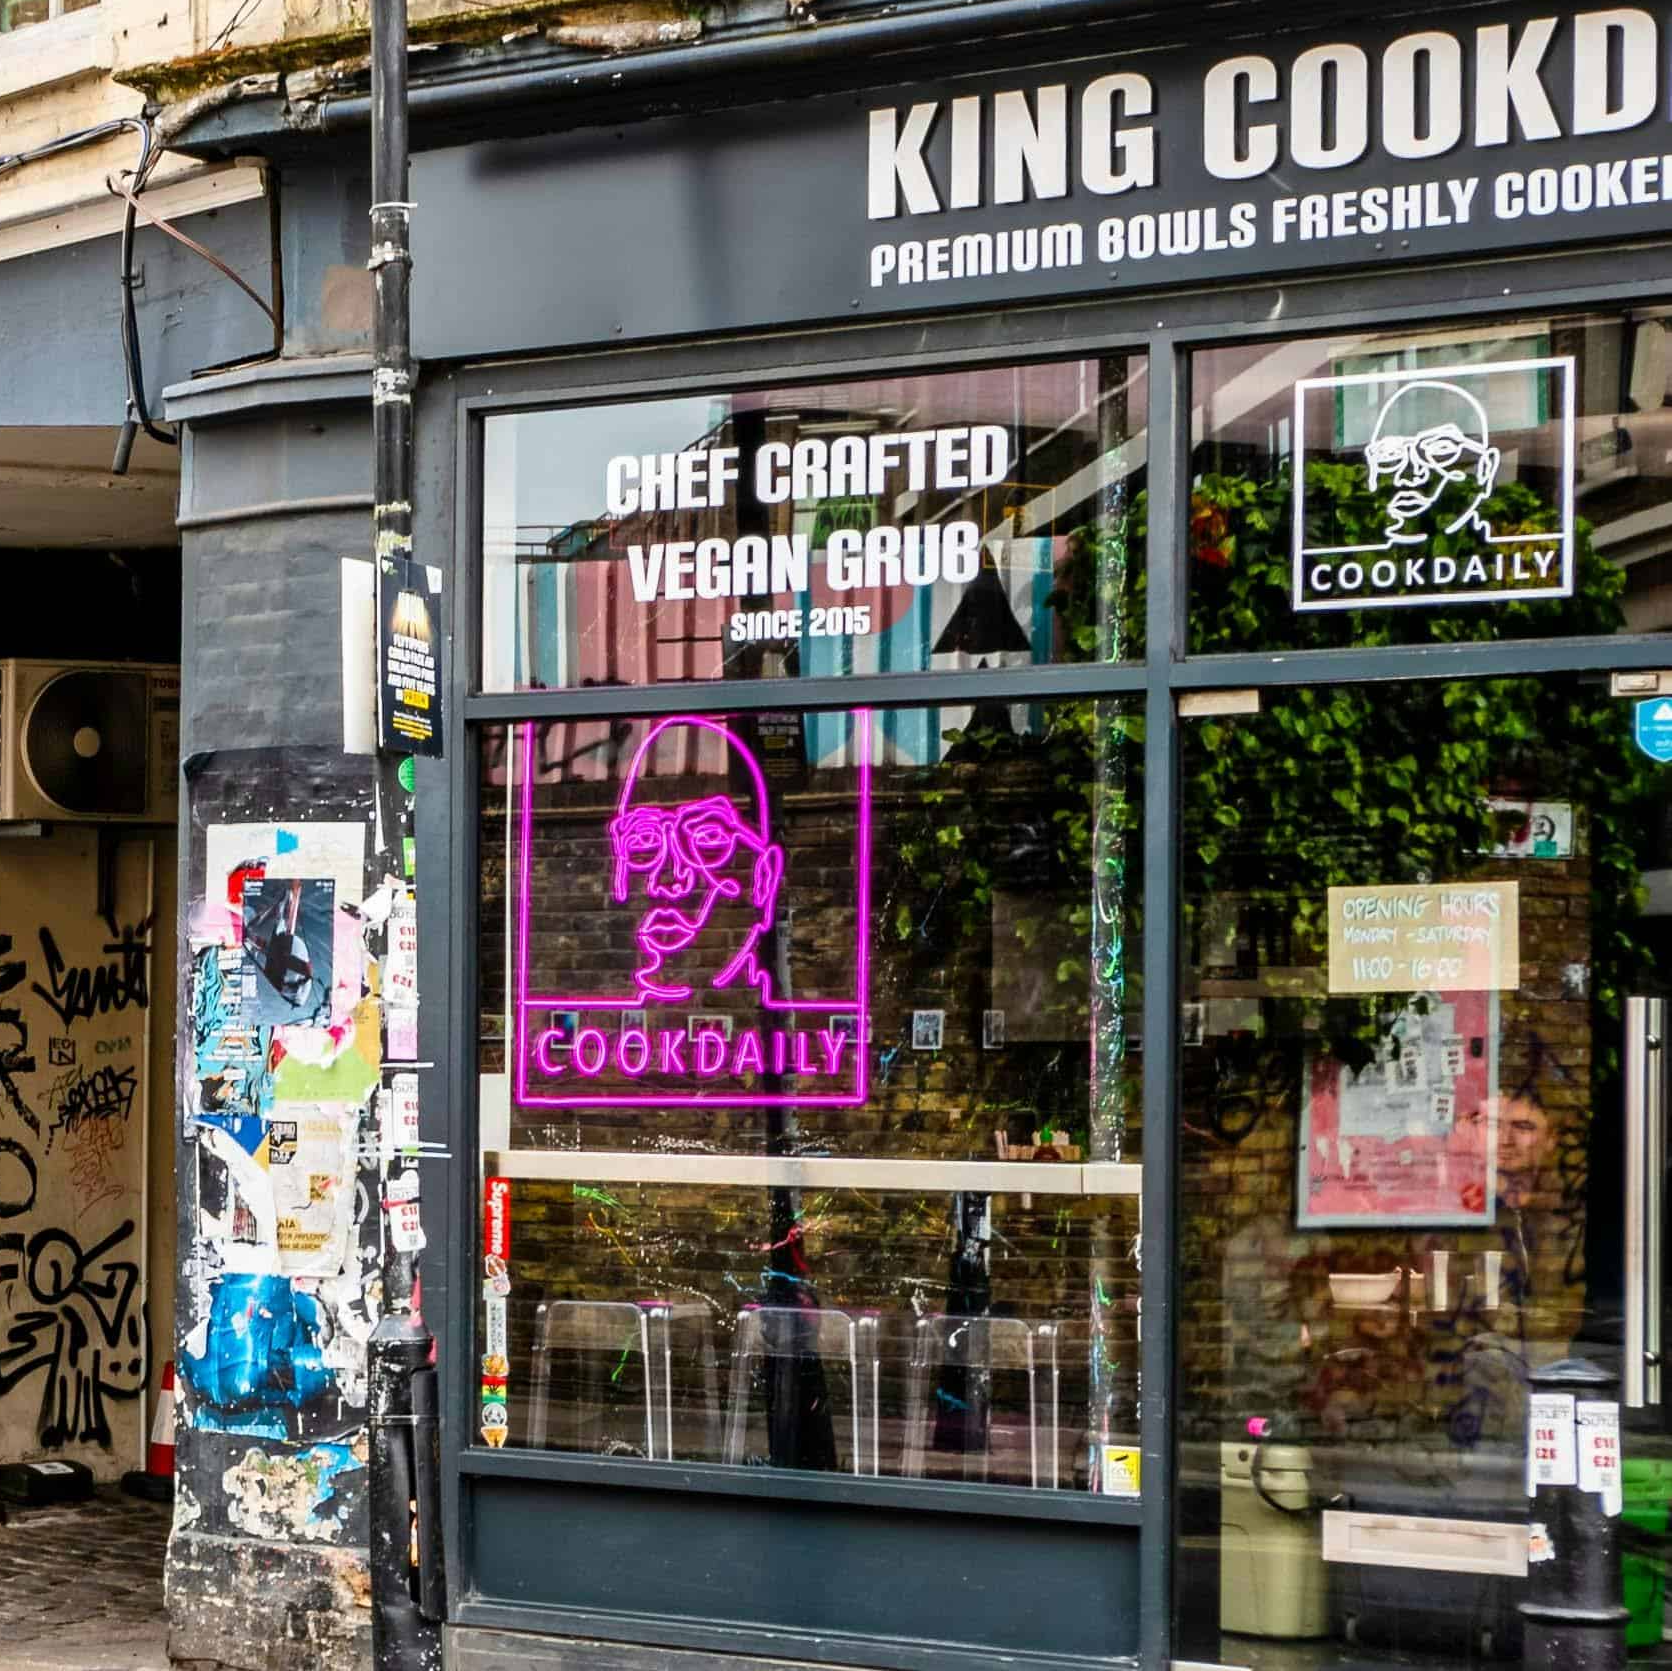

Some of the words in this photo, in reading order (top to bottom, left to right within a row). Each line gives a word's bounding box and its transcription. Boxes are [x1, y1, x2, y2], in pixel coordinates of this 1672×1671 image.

[867, 71, 1155, 220] KING
[1203, 7, 1672, 181] COOKD
[869, 220, 1083, 287] PREMIUM
[1097, 203, 1258, 263] BOWLS
[1272, 176, 1479, 243] FRESHLY
[1493, 155, 1672, 221] COOKE
[605, 446, 740, 515] CHEF
[755, 424, 1009, 504] CRAFTED
[627, 534, 809, 602] VEGAN
[826, 520, 980, 591] GRUB
[1310, 549, 1555, 591] COOKDAILY
[730, 609, 803, 641] SINCE
[808, 605, 871, 637] 2015
[1342, 894, 1433, 920] OPENING
[1439, 891, 1500, 920] HOURS
[1343, 925, 1398, 945] MONDAY
[536, 1028, 847, 1075] COOKDAILY
[488, 1182, 508, 1254] Supreme
